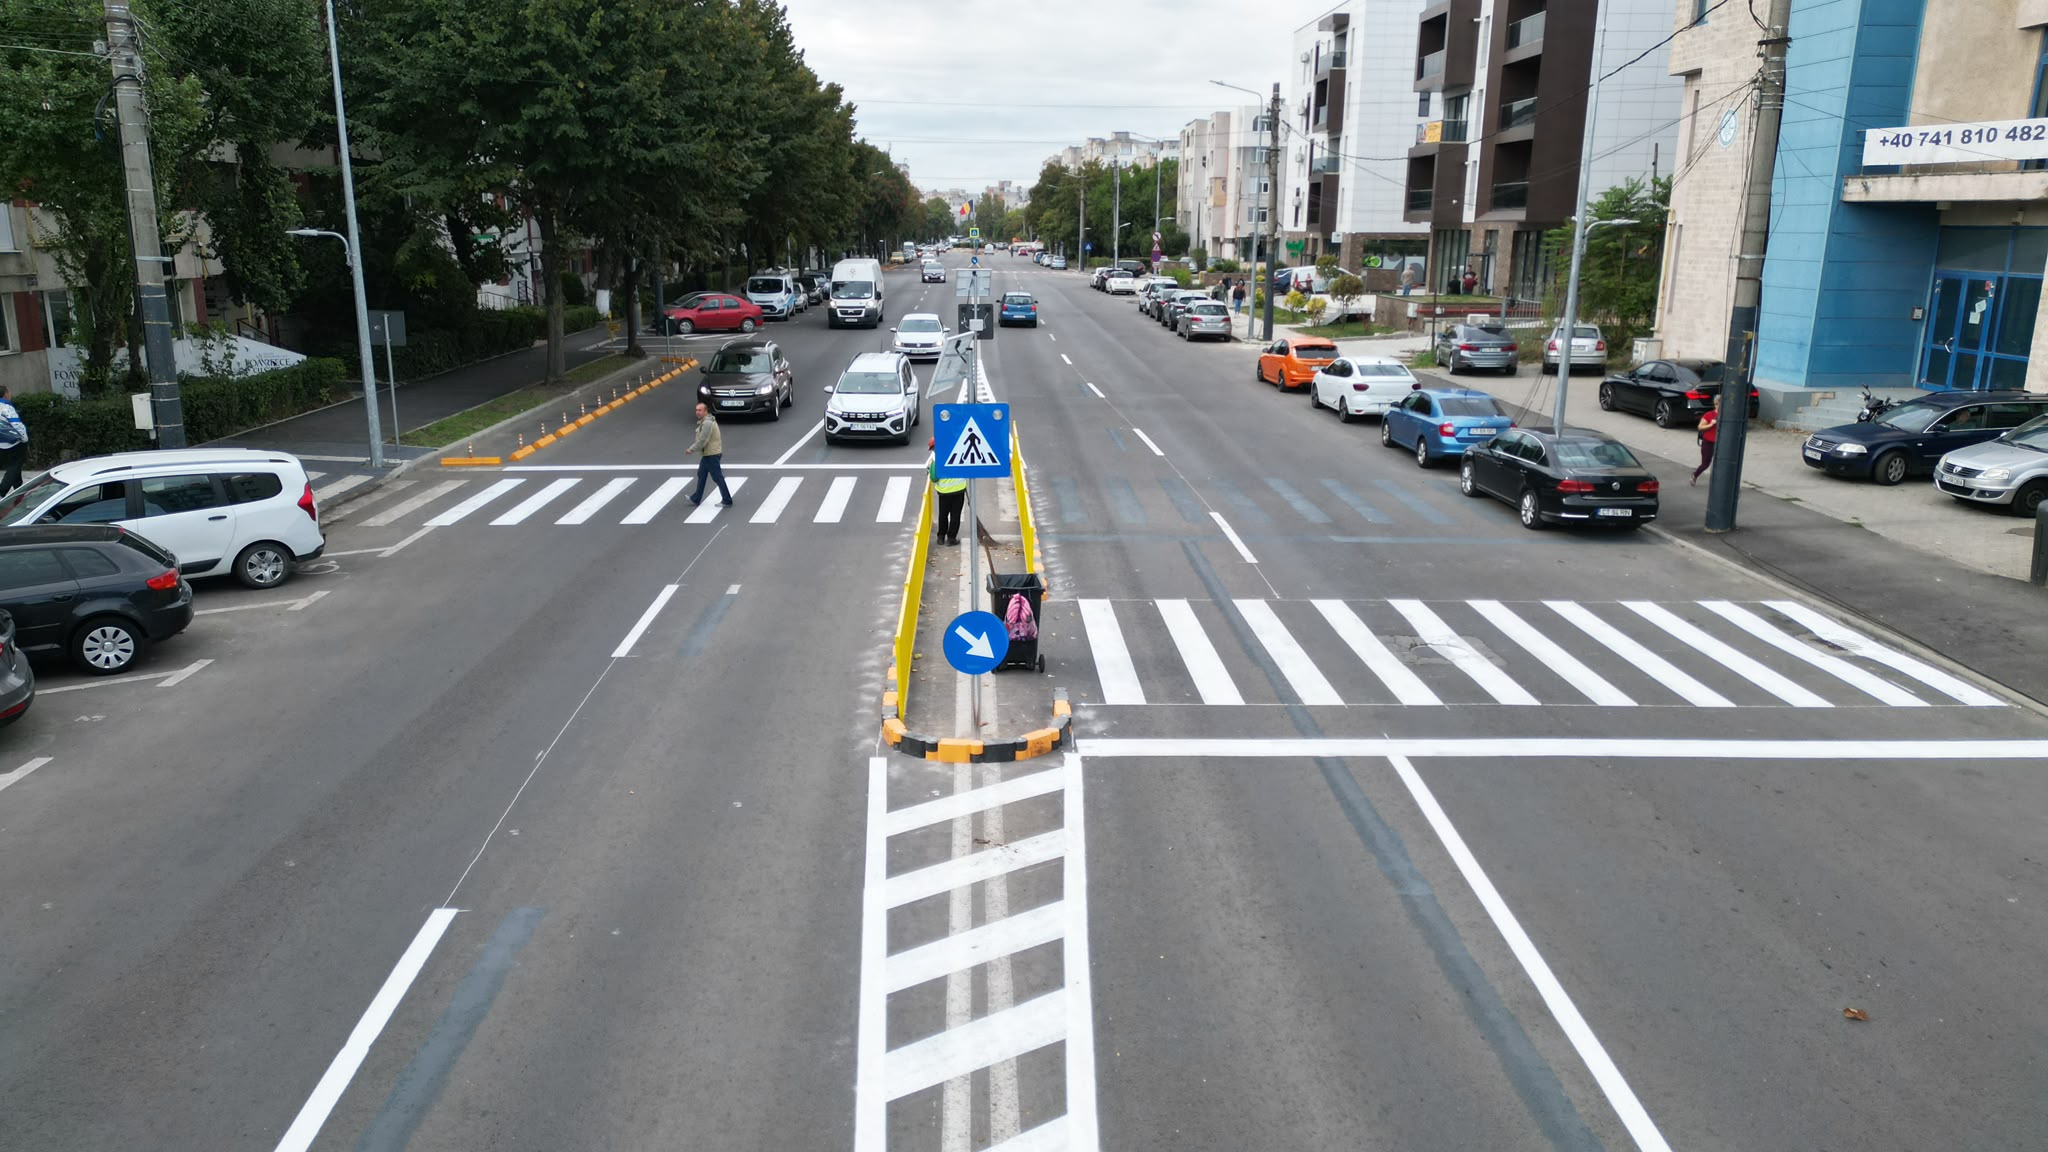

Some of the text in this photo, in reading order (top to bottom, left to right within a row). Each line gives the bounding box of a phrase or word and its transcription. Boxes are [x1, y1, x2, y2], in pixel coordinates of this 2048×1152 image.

[1880, 124, 2046, 148] +40 741 810 482
